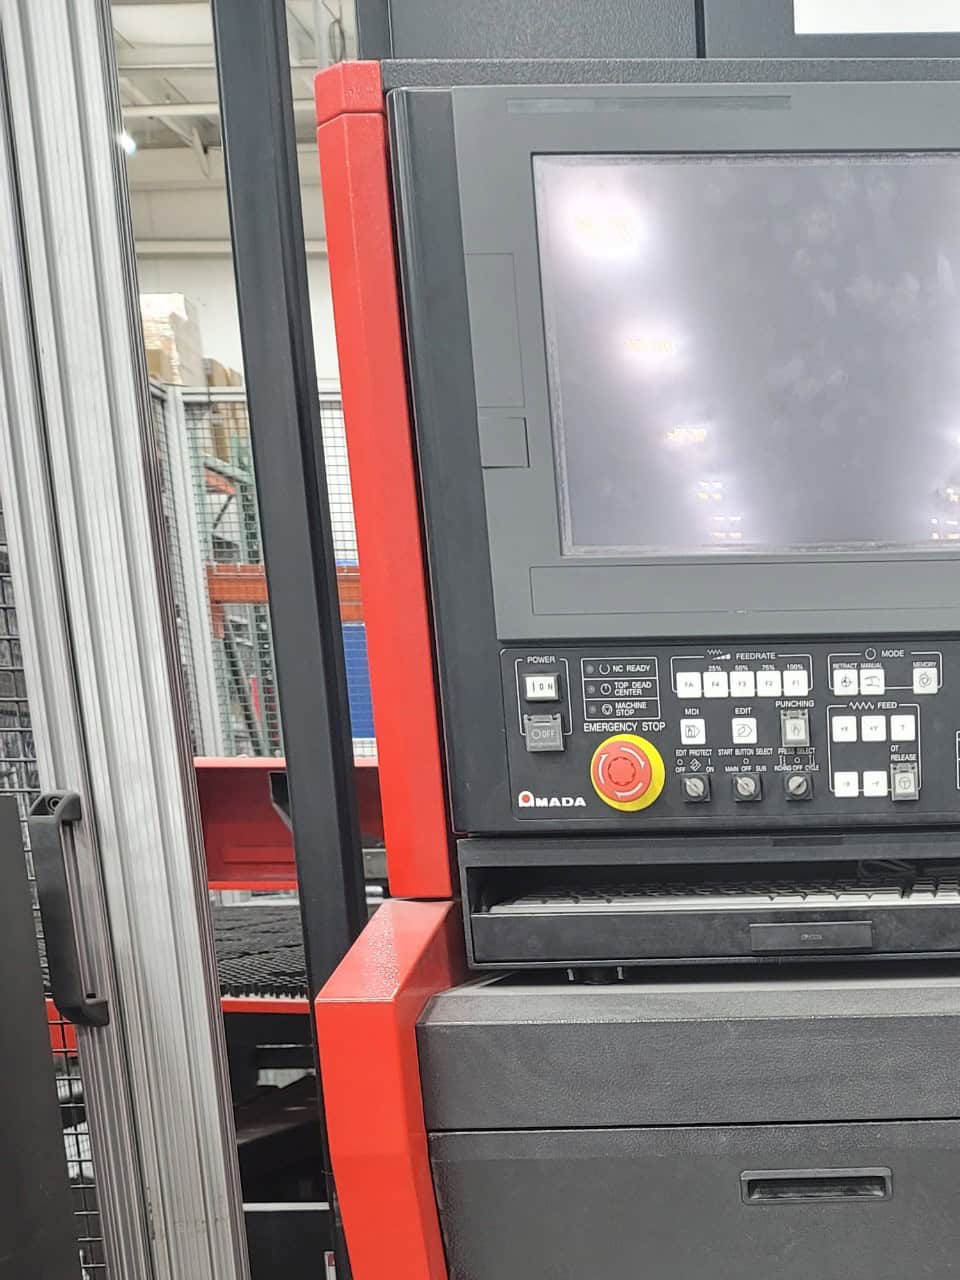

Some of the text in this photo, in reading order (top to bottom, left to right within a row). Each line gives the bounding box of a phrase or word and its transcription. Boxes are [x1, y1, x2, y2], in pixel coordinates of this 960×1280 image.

[527, 656, 555, 664] POWER
[775, 700, 815, 708] PUNCHING
[735, 707, 752, 715] EDIT
[583, 721, 666, 733] EMERGENCY STOP
[542, 730, 555, 738] OFF
[890, 753, 917, 761] RELEASE
[518, 791, 586, 807] AMADA
